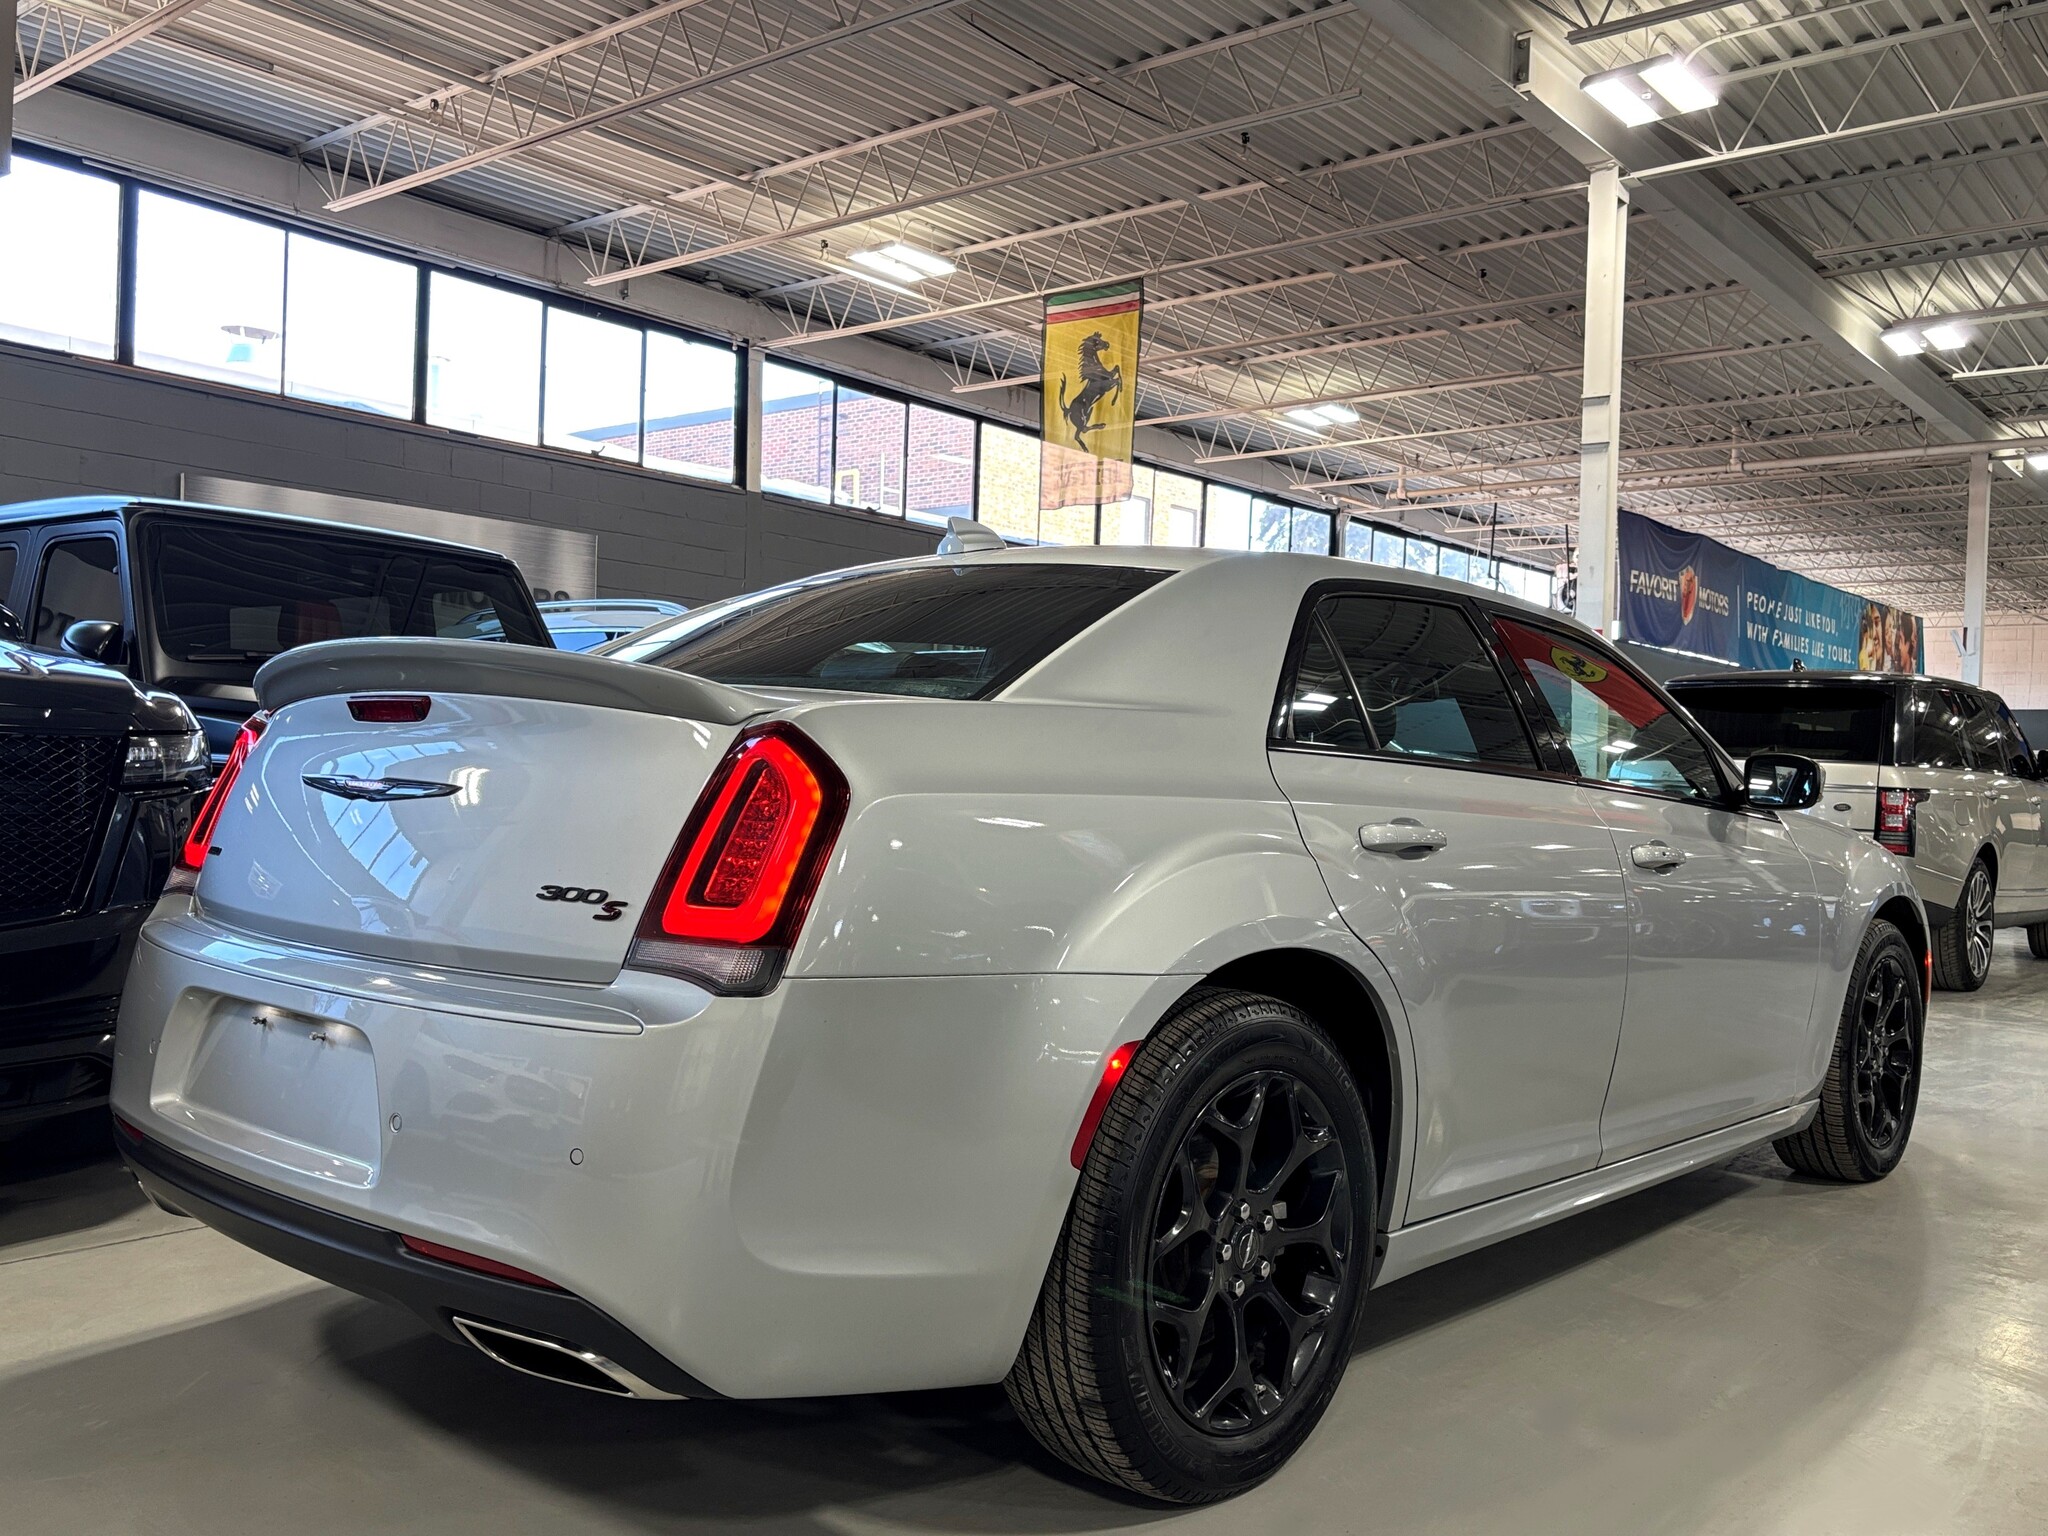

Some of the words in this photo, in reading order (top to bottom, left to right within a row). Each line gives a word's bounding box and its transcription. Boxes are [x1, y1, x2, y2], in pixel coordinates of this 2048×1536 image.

[1629, 569, 1679, 602] FAVORIT
[1698, 586, 1729, 617] MOTORS
[1783, 604, 1803, 625] JUST
[1805, 609, 1821, 631] LIKE
[1746, 621, 1769, 644] WITH
[1772, 629, 1810, 655] FAMILIES
[535, 884, 609, 905] 300
